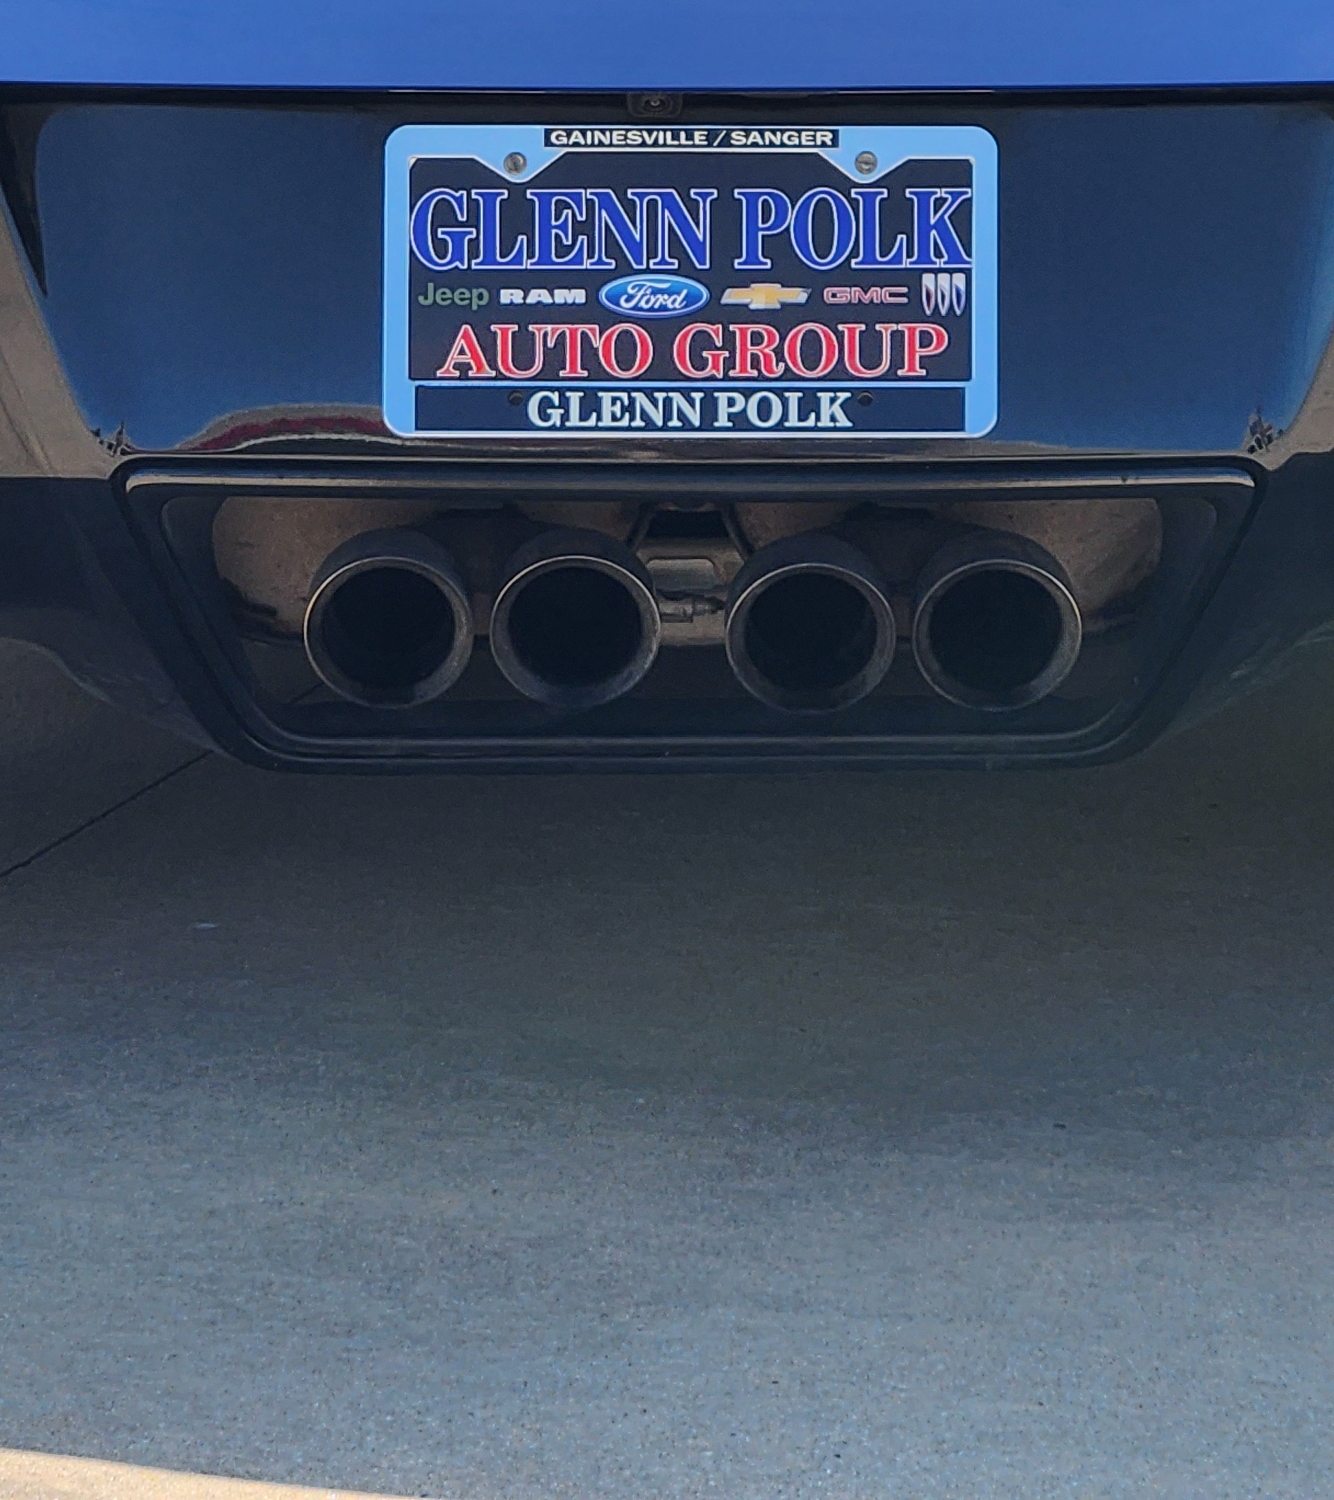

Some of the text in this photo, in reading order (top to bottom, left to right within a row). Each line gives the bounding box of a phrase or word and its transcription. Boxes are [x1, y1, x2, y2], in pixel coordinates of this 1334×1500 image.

[550, 130, 834, 147] GAINESVILLE / SANGER
[410, 187, 973, 271] GLENN POLK
[418, 282, 909, 311] Jeep RAM Ford GMC
[436, 323, 950, 379] AUTO GROUP
[527, 390, 854, 429] GLENN POLK
